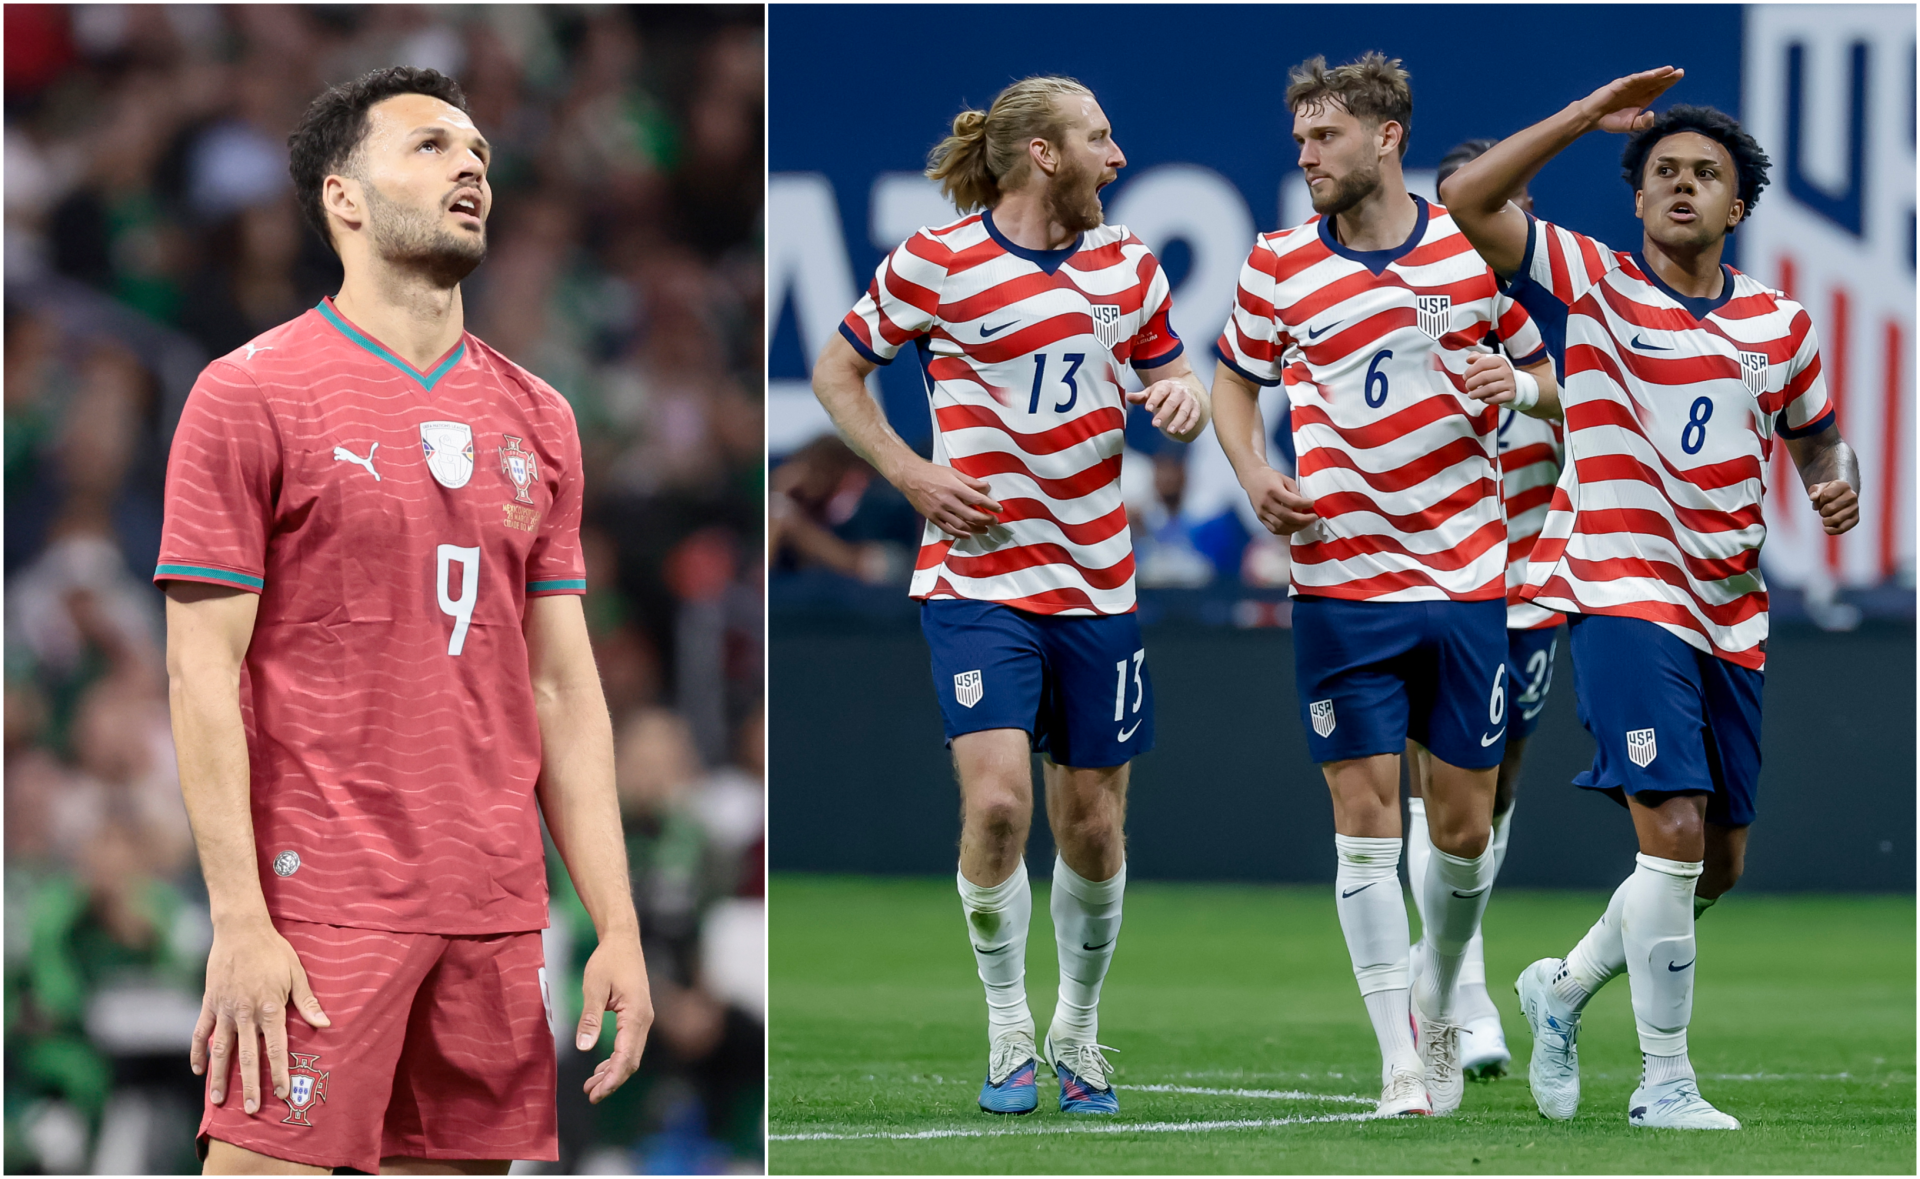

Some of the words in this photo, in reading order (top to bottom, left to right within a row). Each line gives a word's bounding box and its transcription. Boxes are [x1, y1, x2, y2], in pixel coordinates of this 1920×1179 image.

[1093, 307, 1118, 324] USA
[1418, 297, 1449, 314] USA
[1364, 349, 1394, 409] 6
[1741, 353, 1767, 371] USA
[1028, 353, 1086, 414] 13
[1681, 396, 1714, 455] 8
[436, 543, 481, 656] 9
[956, 672, 980, 688] USA
[1114, 647, 1145, 722] 13
[1489, 662, 1505, 725] 6
[1311, 701, 1331, 717] USA
[1629, 730, 1653, 746] USA
